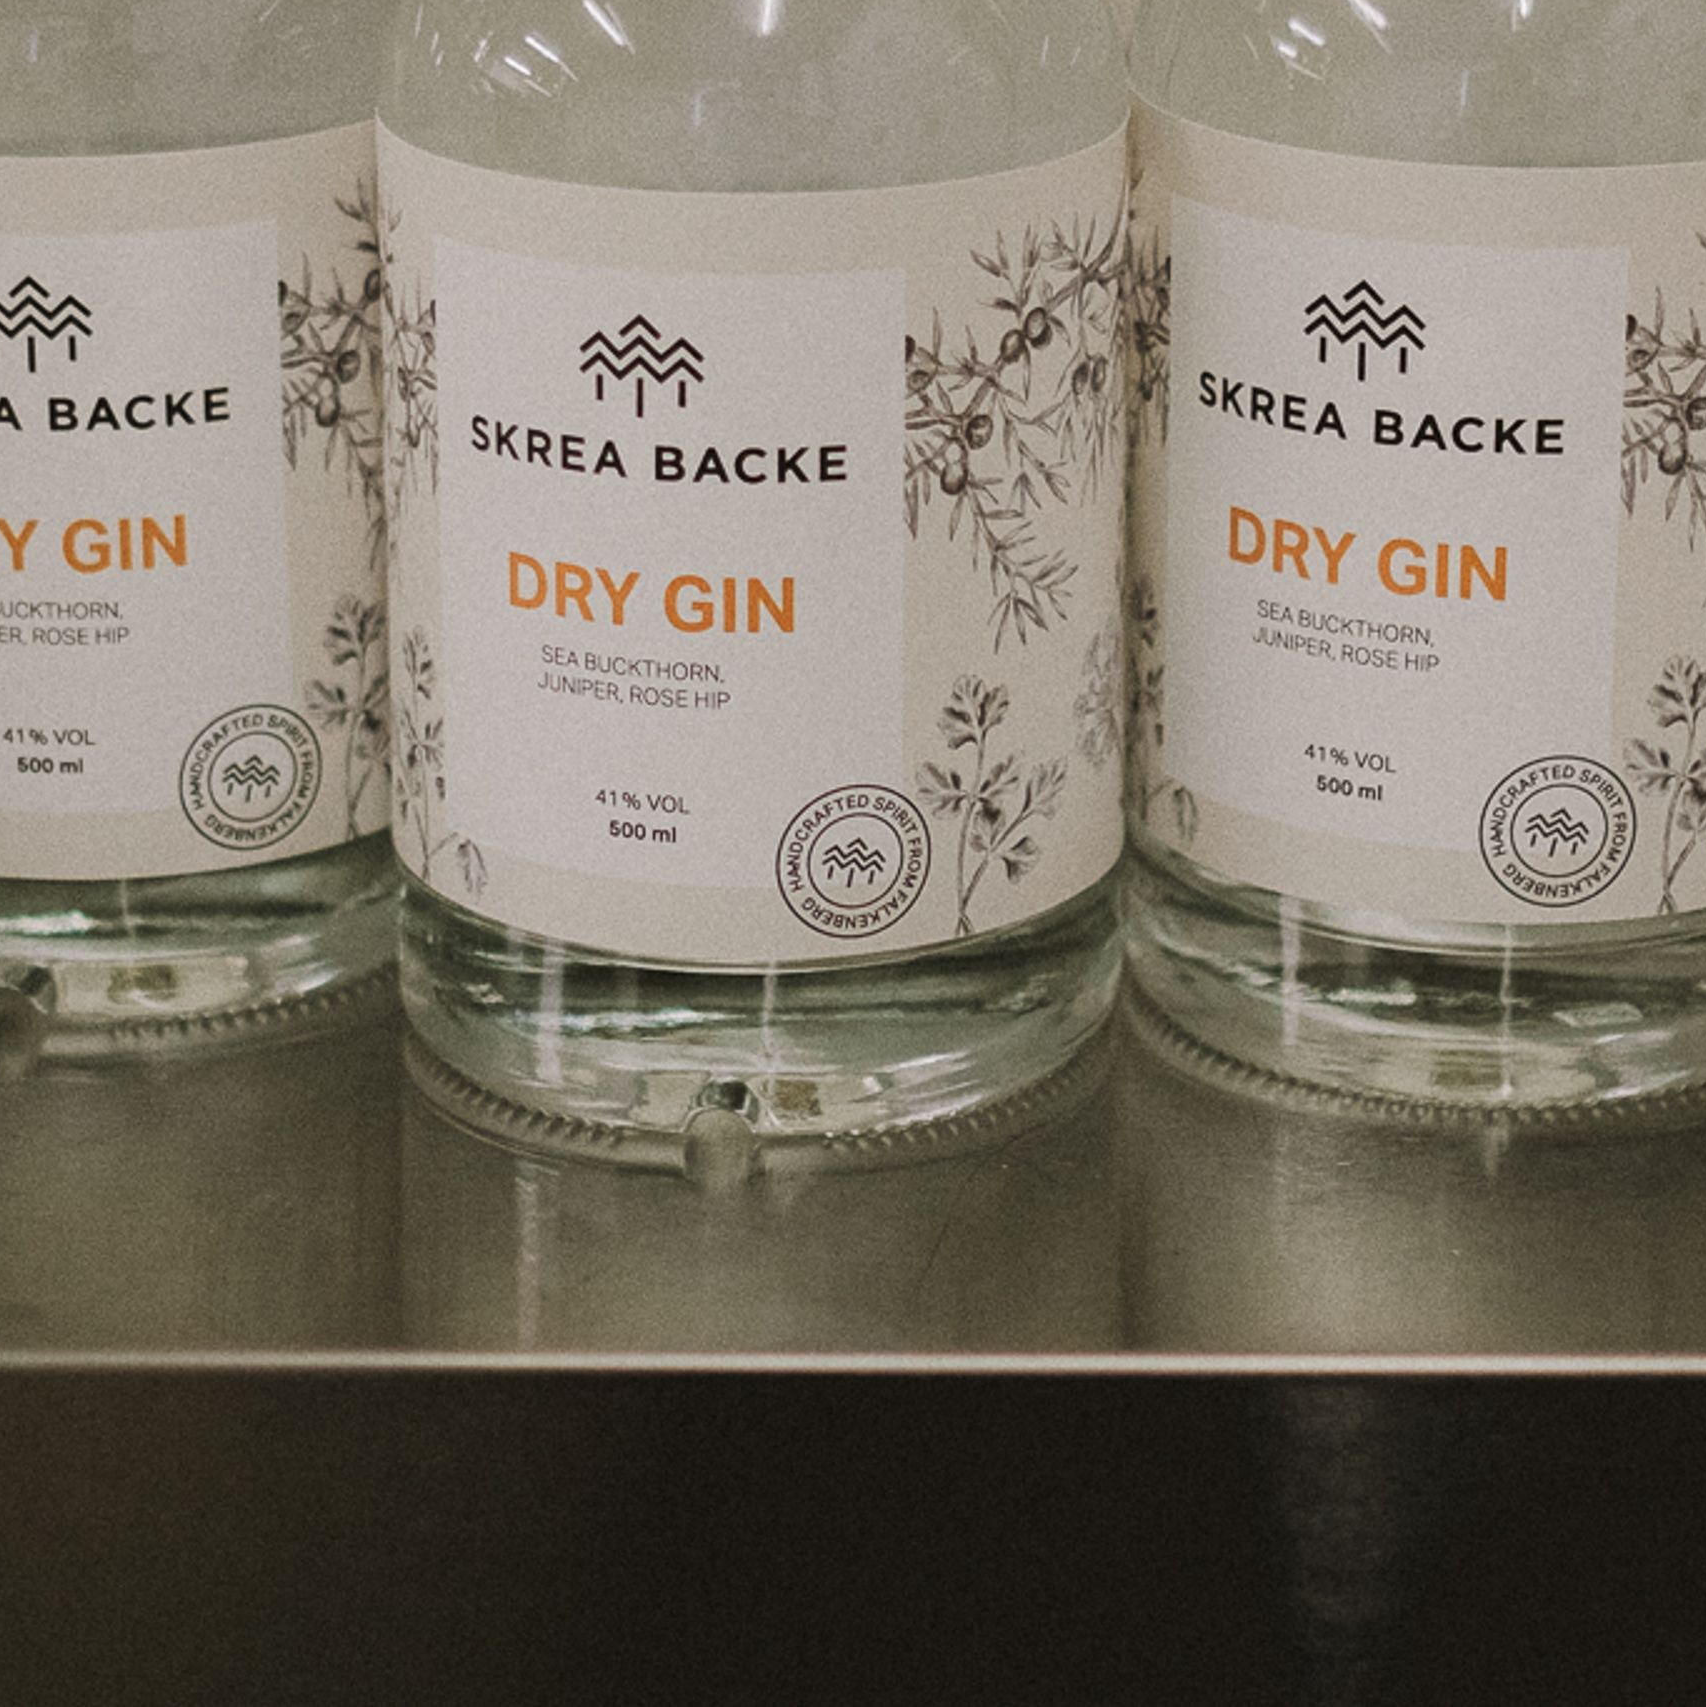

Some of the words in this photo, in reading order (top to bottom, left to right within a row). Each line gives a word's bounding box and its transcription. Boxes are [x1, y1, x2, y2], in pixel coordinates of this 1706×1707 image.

[48, 387, 229, 431] BACKE
[1199, 371, 1346, 439] SKREA
[1374, 410, 1564, 454] BACKE
[472, 416, 626, 477] SKREA
[655, 445, 846, 484] BACKE
[62, 515, 186, 573] GIN
[1229, 506, 1355, 584] DRY
[1378, 539, 1507, 601] GIN
[509, 552, 640, 625] DRY
[664, 575, 794, 633] GIN
[32, 628, 90, 646] ROSE
[95, 626, 130, 644] HIP
[1257, 599, 1293, 622] SEA
[1298, 607, 1434, 649] BUCKTHORN,
[542, 644, 579, 670] SEA
[584, 652, 725, 683] BUCKTHORN,
[1252, 627, 1336, 661] JUNIPER,
[1341, 642, 1398, 670] ROSE
[1405, 653, 1440, 671] HIP
[537, 672, 624, 703] JUNIPER,
[629, 685, 688, 708] ROSE
[695, 691, 731, 709] HIP
[53, 729, 95, 746] VOL
[268, 714, 308, 748] SPIRIT
[298, 750, 313, 798] FROM
[17, 757, 54, 773] 500
[60, 760, 84, 774] ml
[1354, 752, 1396, 773] VOL
[646, 794, 689, 814] VOL
[1317, 775, 1353, 796] 500
[1358, 781, 1383, 801] ml
[1579, 769, 1624, 808] SPIRIT
[610, 820, 646, 840] 500
[653, 825, 677, 843] ml
[873, 797, 918, 834] SPIRIT
[1490, 765, 1576, 858] HANDCRAFTED
[787, 795, 869, 893] HANDCRAFTED
[1607, 811, 1628, 863] FROM
[903, 836, 922, 889] FROM
[1502, 862, 1612, 898] FALKENBERG
[802, 889, 908, 929] FALKENBERG
